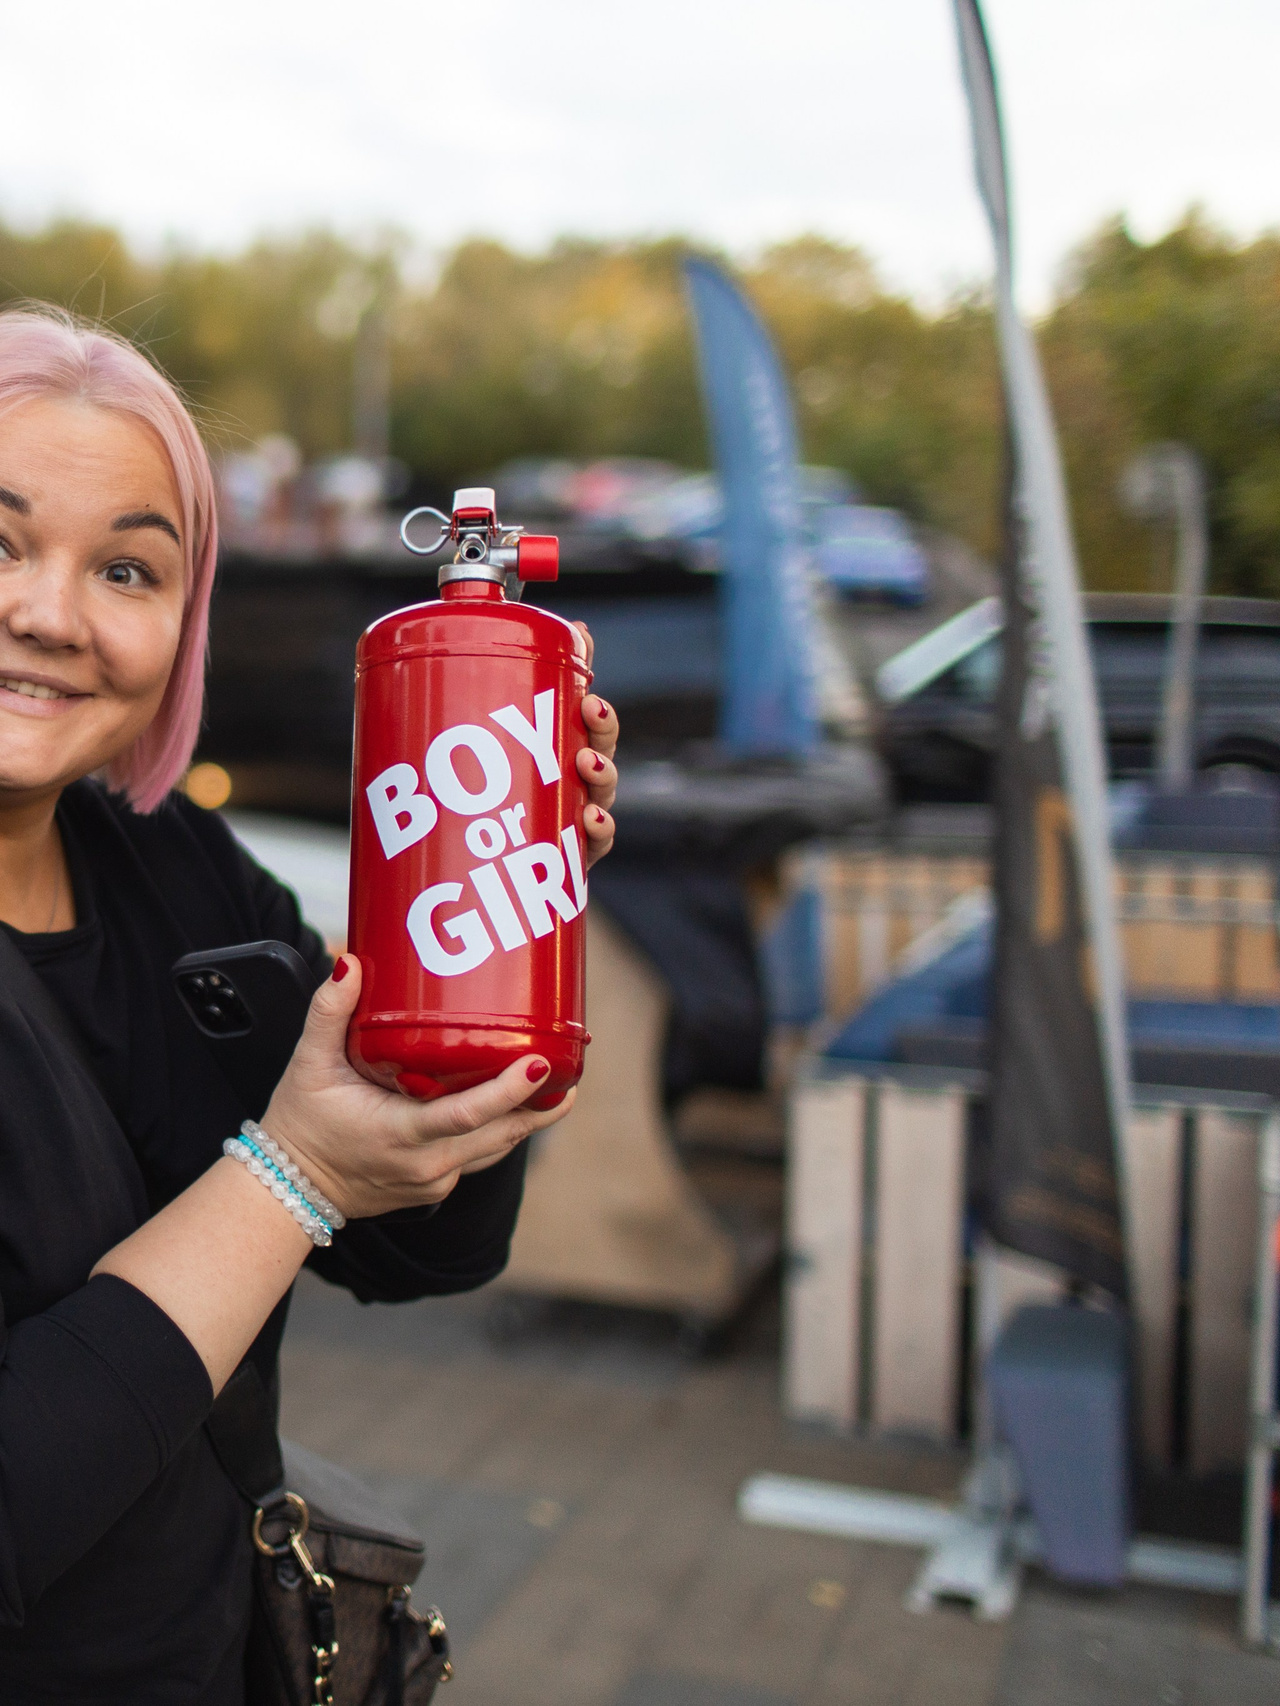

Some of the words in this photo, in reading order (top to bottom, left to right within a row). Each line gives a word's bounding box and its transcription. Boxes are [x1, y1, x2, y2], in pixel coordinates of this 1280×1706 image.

[366, 688, 562, 860] BOY
[465, 802, 527, 859] or
[406, 824, 588, 977] GIRL
